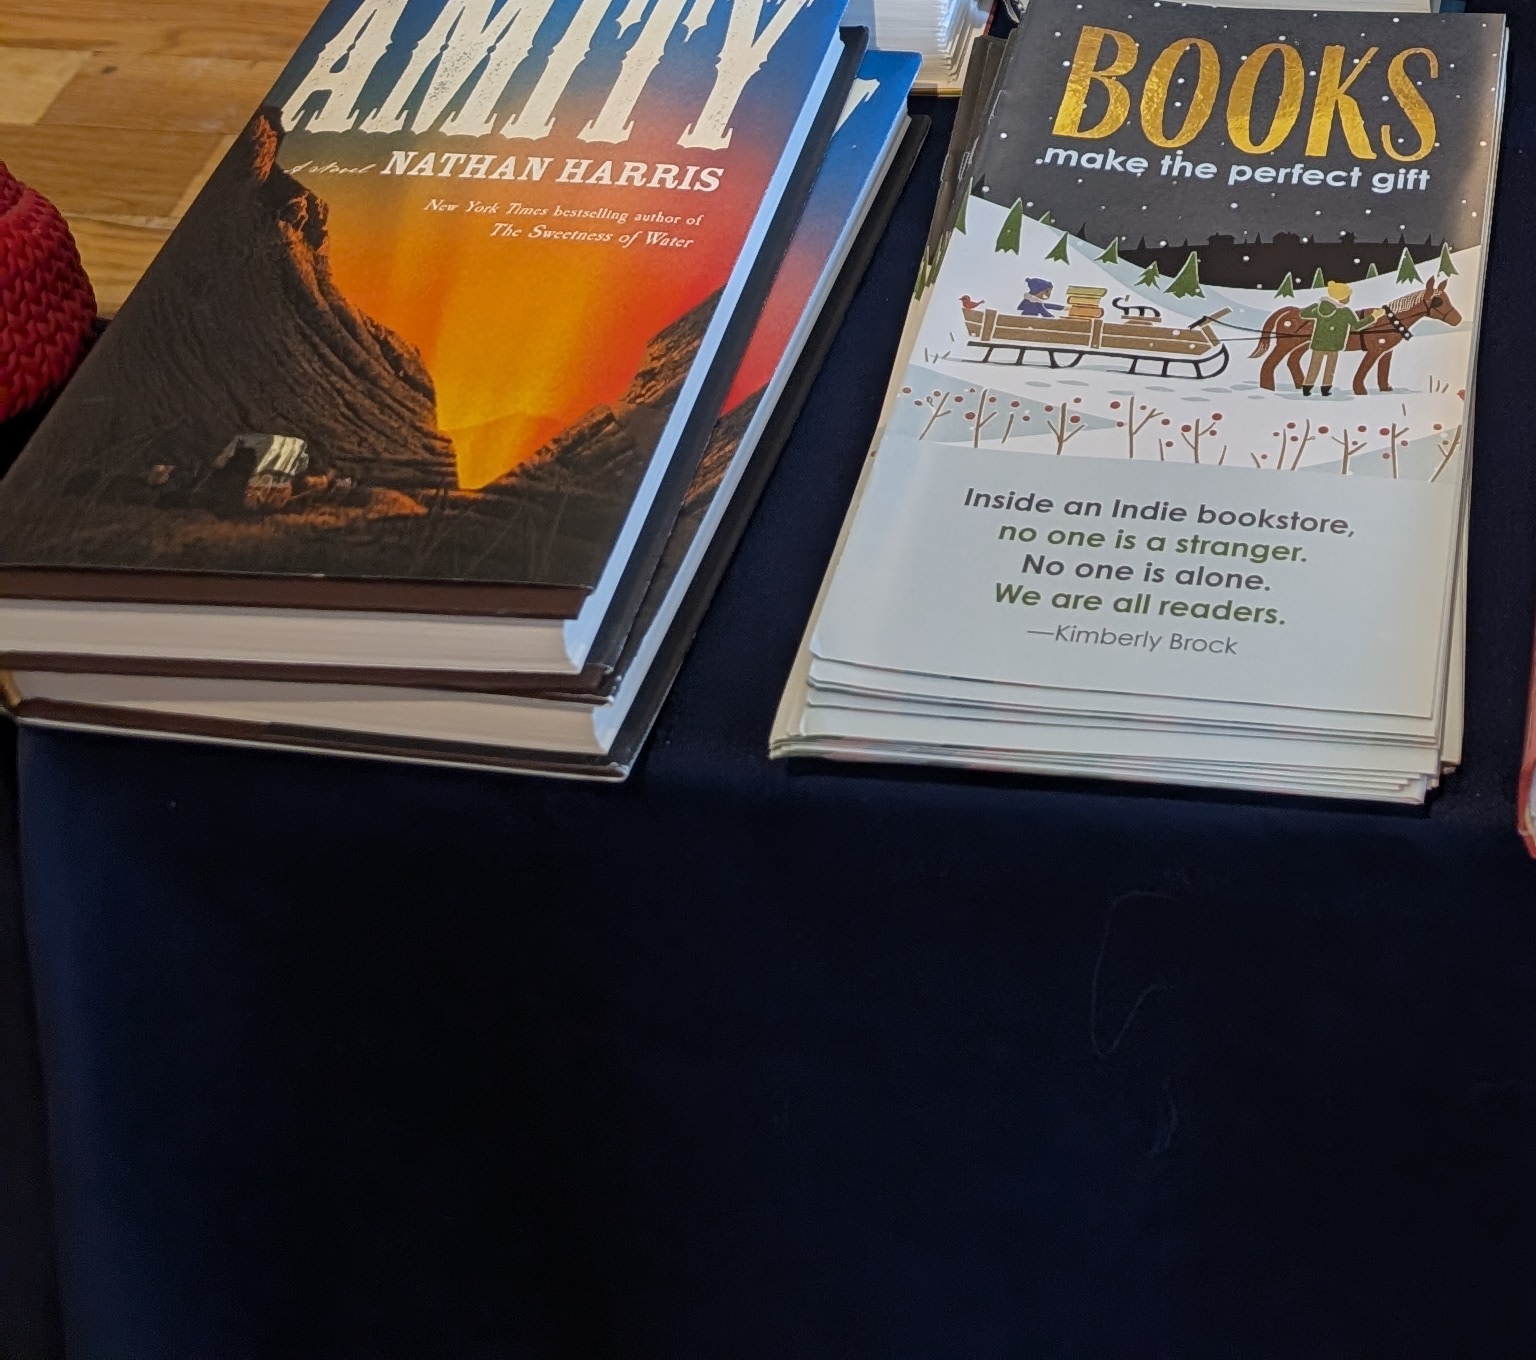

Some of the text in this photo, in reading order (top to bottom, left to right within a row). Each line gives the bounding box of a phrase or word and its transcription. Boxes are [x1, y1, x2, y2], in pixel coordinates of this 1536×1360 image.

[380, 151, 724, 192] NATHAN HARRIS
[424, 200, 704, 226] New York Times bestselling author of
[490, 223, 694, 249] The Sweetness of Water
